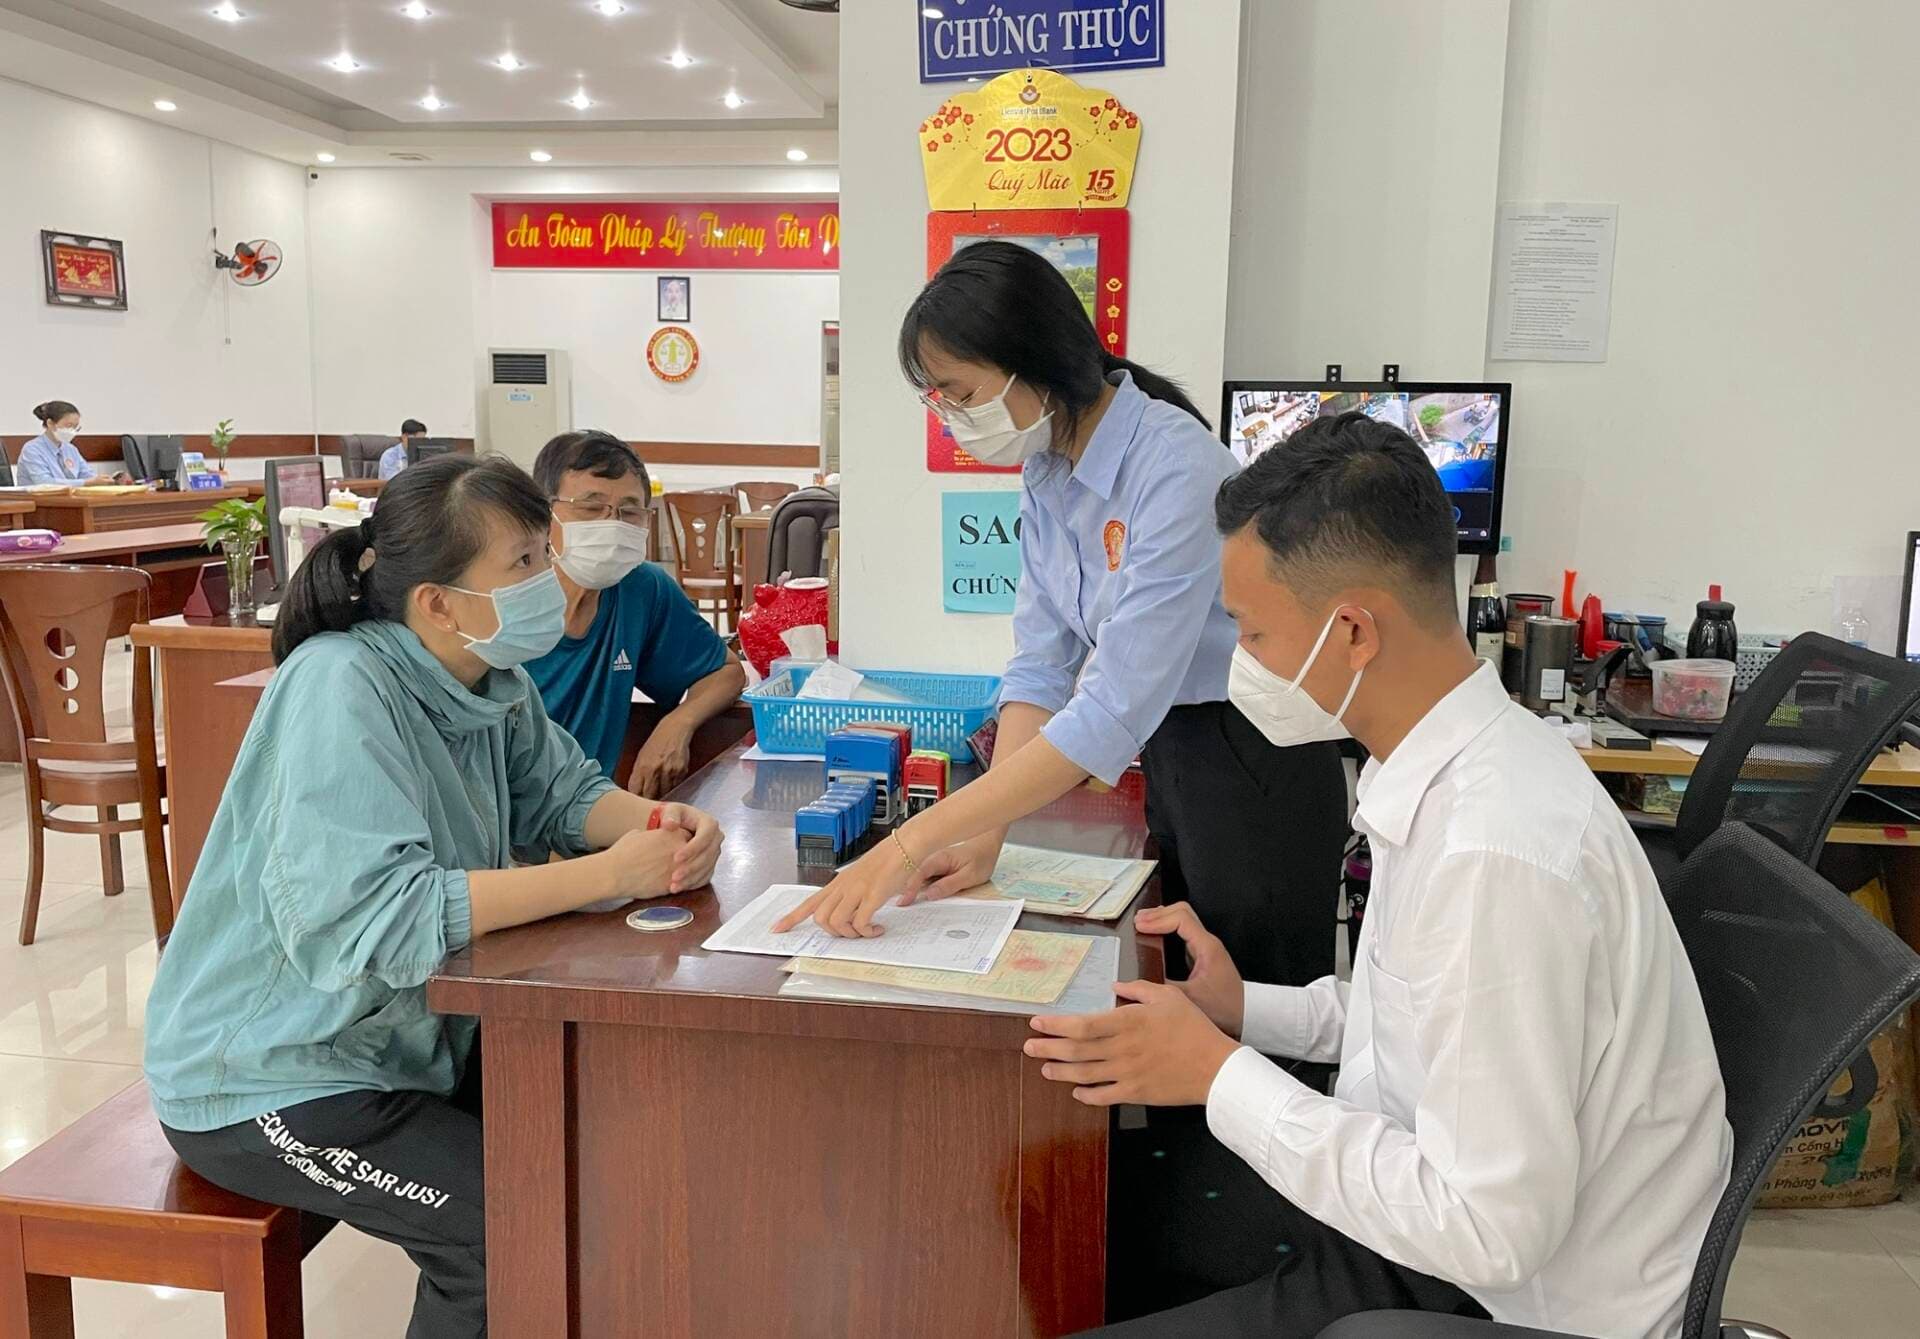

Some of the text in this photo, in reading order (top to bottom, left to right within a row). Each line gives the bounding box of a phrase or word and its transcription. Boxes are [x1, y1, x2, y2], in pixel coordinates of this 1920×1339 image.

[934, 0, 1150, 60] CHỨNG THỰC
[985, 128, 1072, 162] 2023
[988, 169, 1024, 200] Quý
[1086, 169, 1115, 190] 15
[507, 213, 541, 248] An
[547, 213, 593, 248] Toàn
[600, 213, 654, 256] Pháp
[697, 212, 766, 256] Thượng
[776, 213, 812, 249] Tôn
[352, 1160, 399, 1192] SAR
